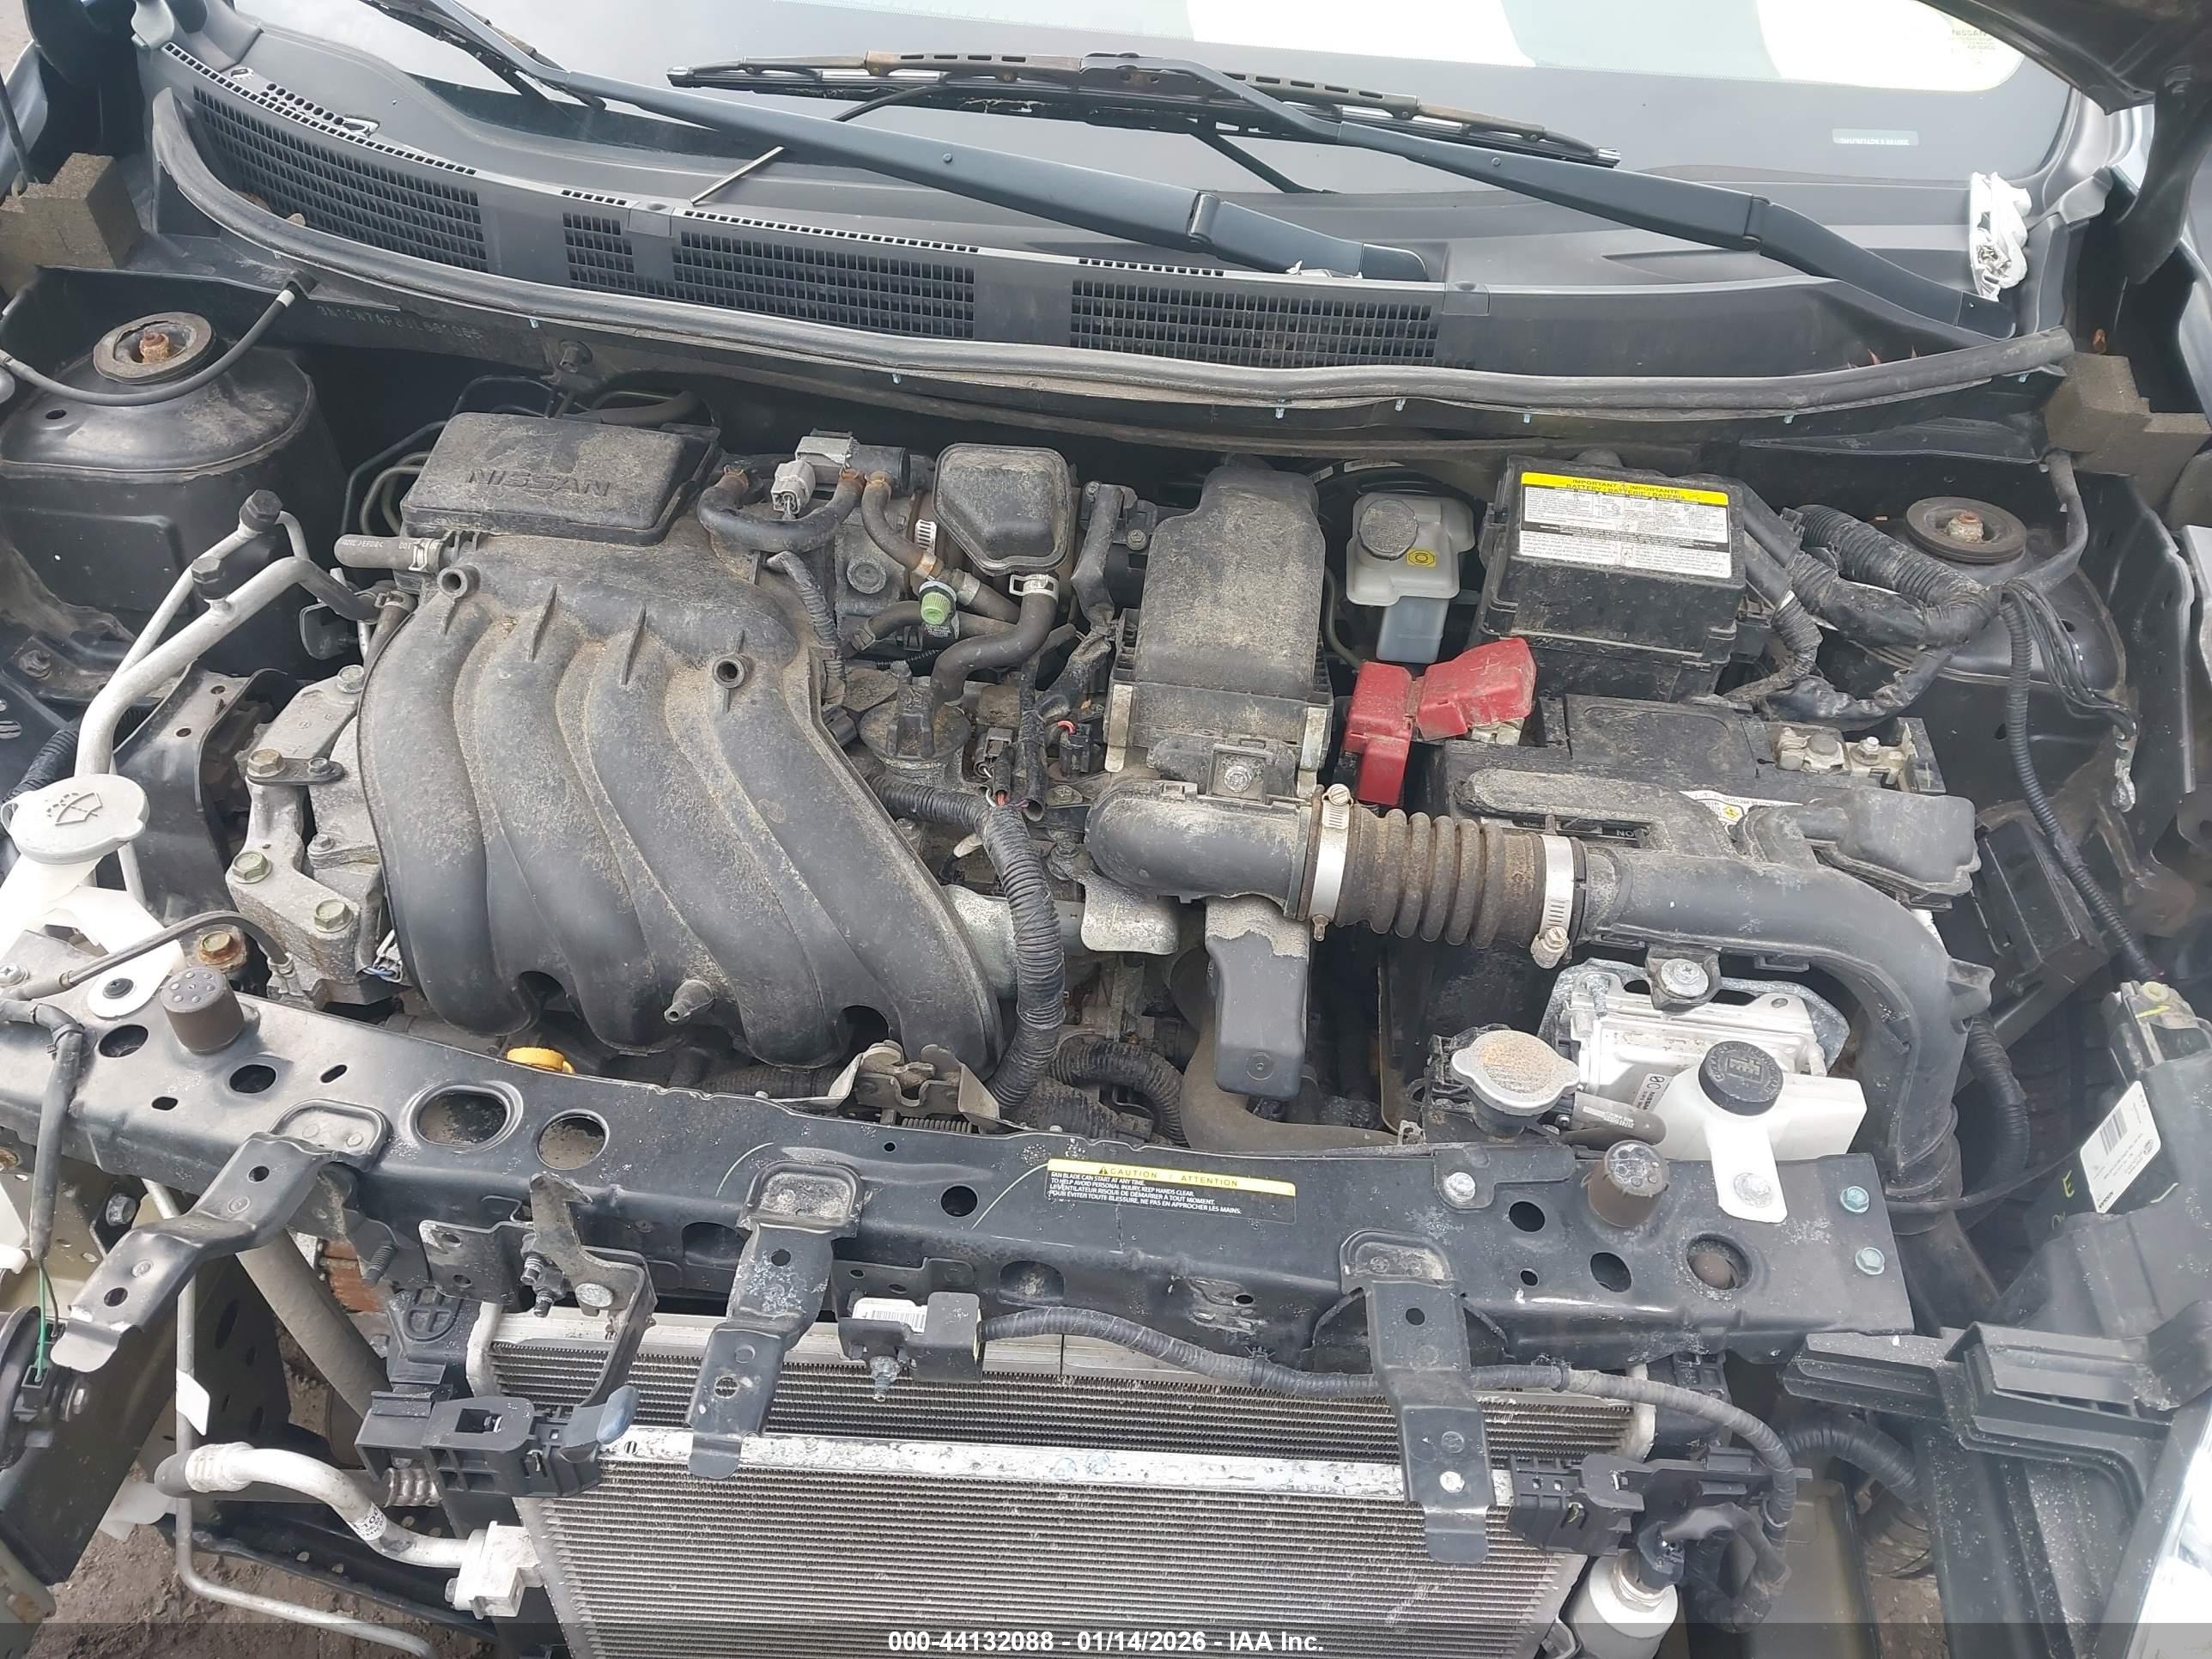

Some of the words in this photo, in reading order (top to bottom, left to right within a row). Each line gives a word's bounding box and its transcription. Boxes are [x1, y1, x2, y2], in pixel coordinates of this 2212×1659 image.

[469, 470, 611, 497] NISSAN
[1572, 479, 1617, 488] IMPORTANT
[1110, 1168, 1158, 1179] CAUTION
[1182, 1176, 1237, 1187] ATTENTION
[1058, 1184, 1097, 1193] VENTILATEUR
[1171, 1202, 1207, 1211] APPROCHER
